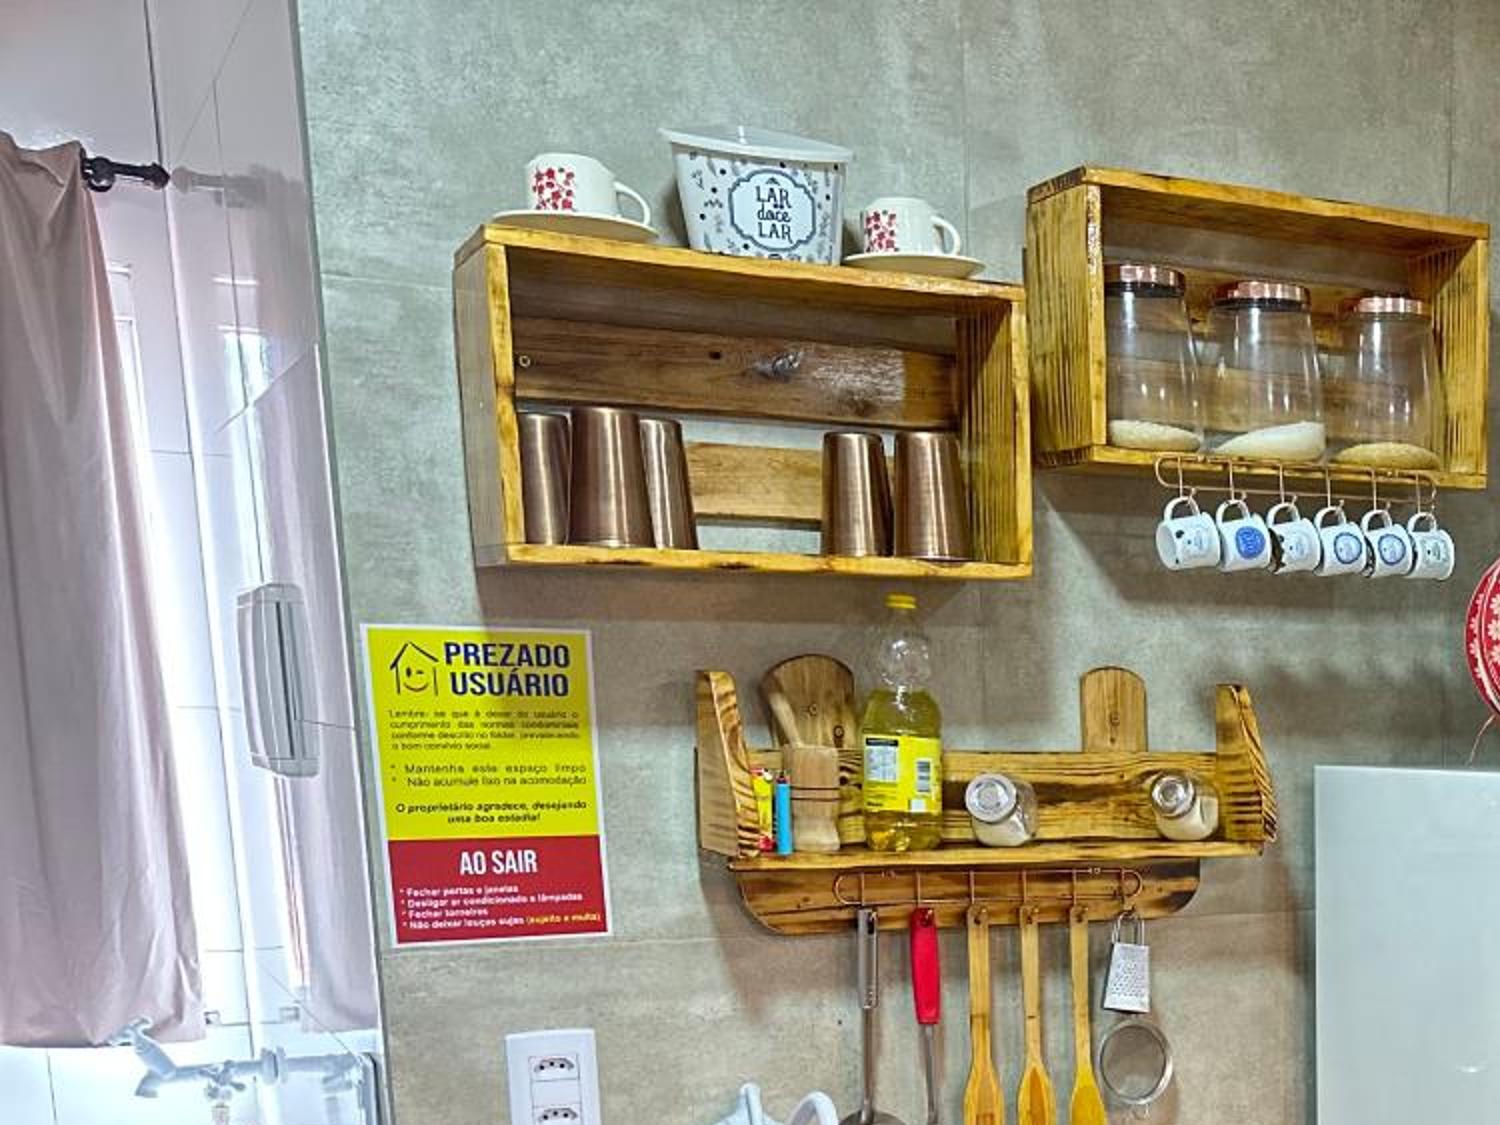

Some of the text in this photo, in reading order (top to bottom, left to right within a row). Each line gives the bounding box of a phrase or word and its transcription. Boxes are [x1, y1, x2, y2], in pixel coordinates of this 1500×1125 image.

[756, 186, 792, 208] LAR
[758, 222, 793, 244] LAR
[444, 642, 570, 668] PREZADO
[451, 668, 569, 697] USUÁRIO
[396, 803, 405, 813] O
[475, 813, 494, 823] boa
[459, 850, 538, 875] AO SAIR
